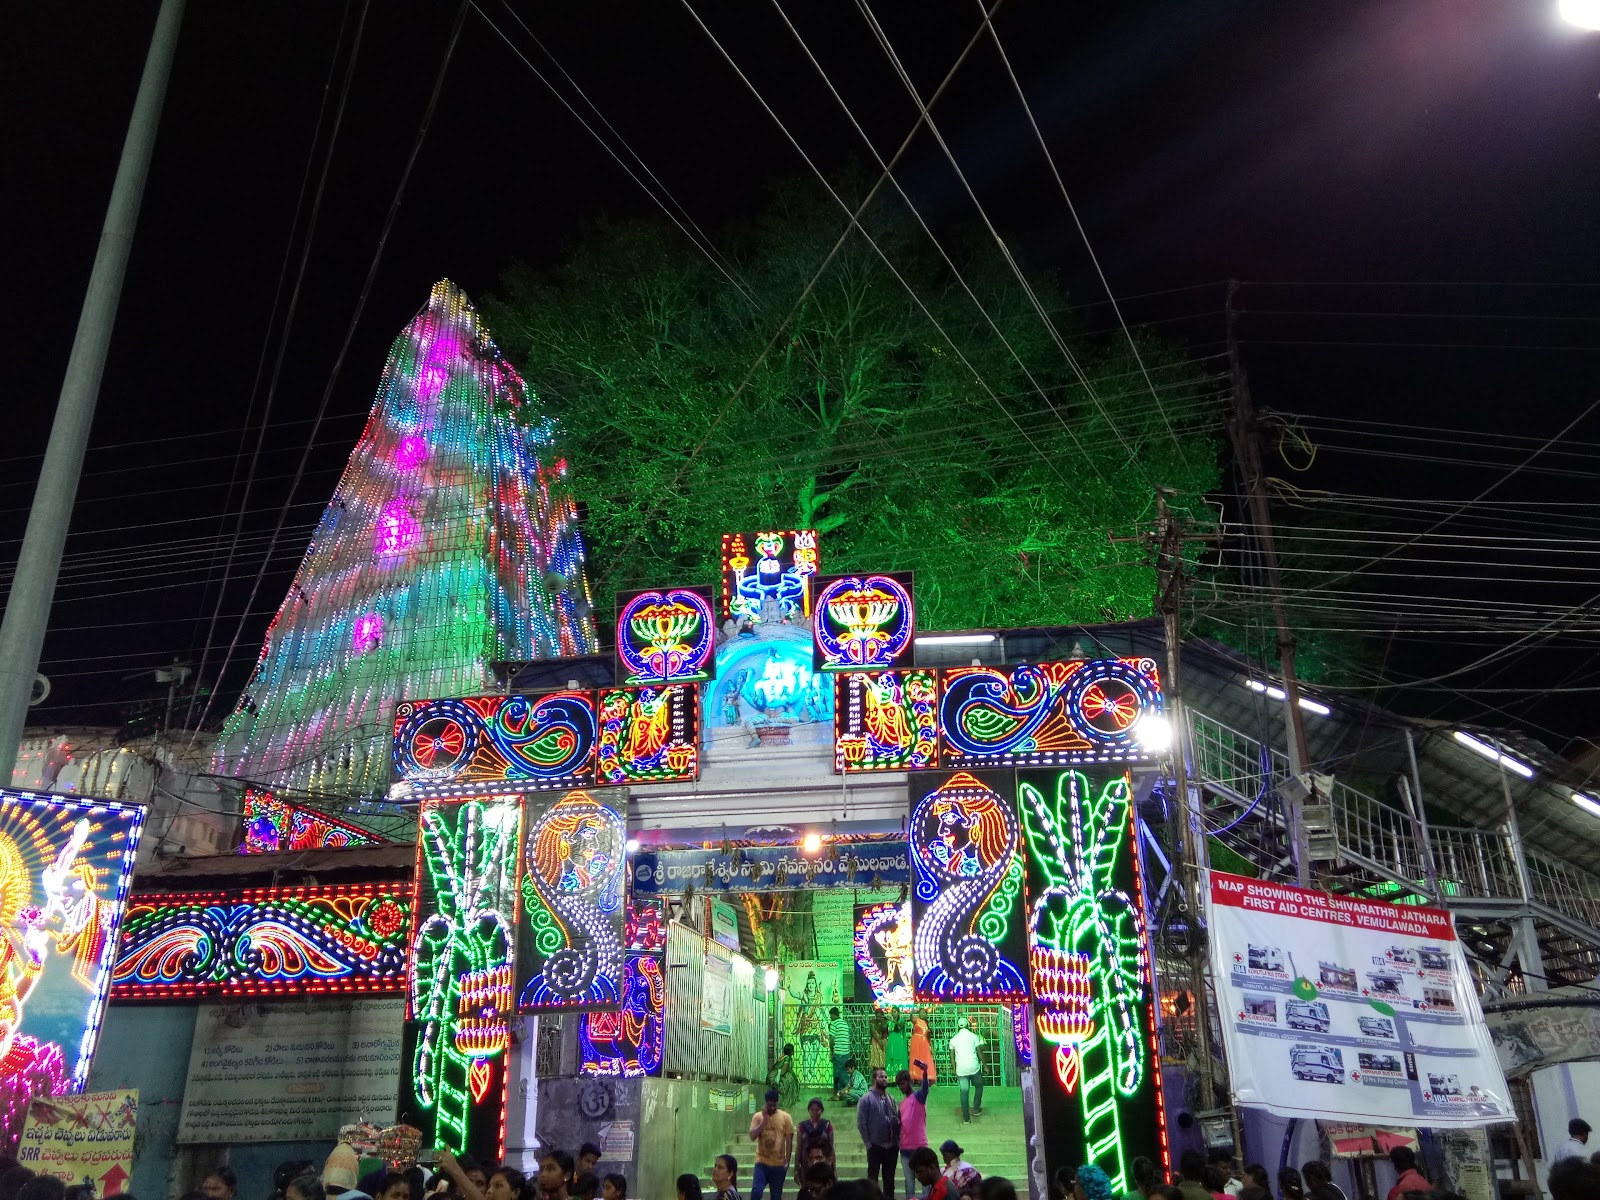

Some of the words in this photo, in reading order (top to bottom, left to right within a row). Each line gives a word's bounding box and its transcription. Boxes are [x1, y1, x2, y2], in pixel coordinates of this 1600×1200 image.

[1218, 880, 1244, 893] MAP
[1247, 885, 1302, 903] SHOWING
[1304, 894, 1327, 907] THE
[1329, 899, 1399, 918] SHIVARATHRI
[1401, 910, 1447, 926] JATHARA
[1243, 896, 1276, 911] FIRST
[1279, 904, 1298, 914] AID
[1301, 905, 1354, 925] CENTRES,
[1356, 914, 1429, 935] VEMULAWADA
[1433, 1094, 1447, 1103] 104
[20, 1147, 41, 1161] SRR
